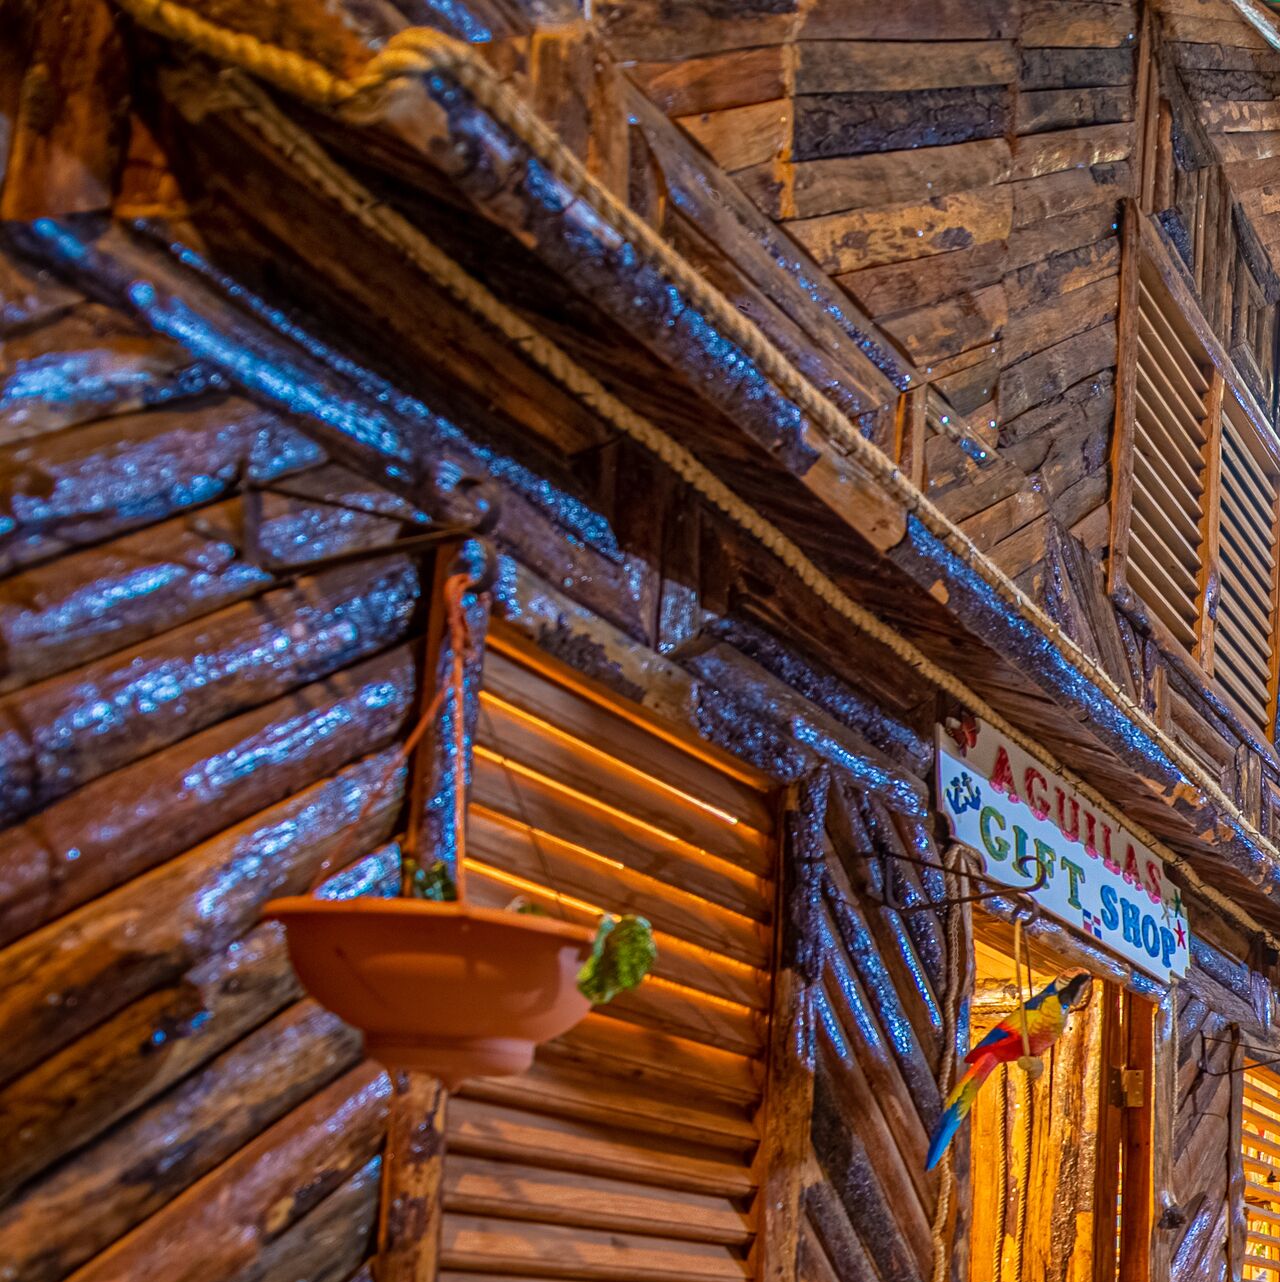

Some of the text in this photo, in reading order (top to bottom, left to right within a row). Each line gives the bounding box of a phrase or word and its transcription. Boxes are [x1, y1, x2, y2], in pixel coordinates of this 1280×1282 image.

[979, 805, 1177, 968] GIFT SHOP
[989, 745, 1162, 904] AGUILAS
